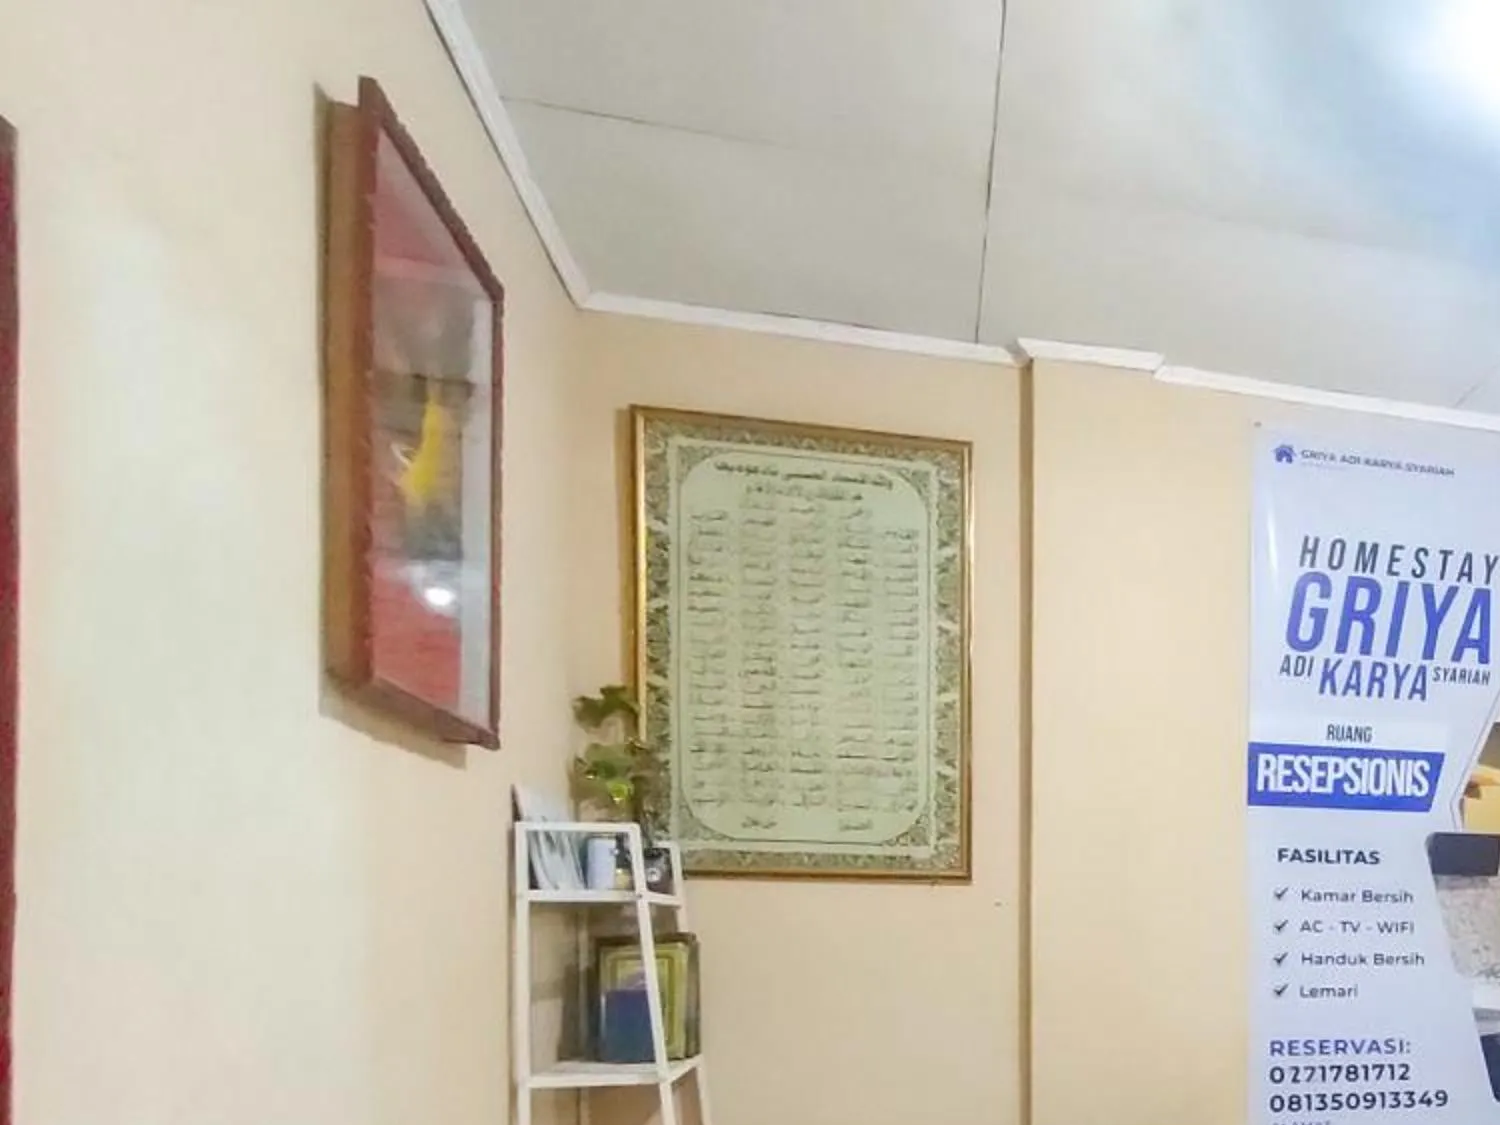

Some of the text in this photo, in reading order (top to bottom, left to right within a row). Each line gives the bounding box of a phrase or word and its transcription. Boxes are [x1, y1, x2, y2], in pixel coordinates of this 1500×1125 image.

[1299, 535, 1500, 585] HOMESTAY
[1286, 571, 1491, 665] GRIYA
[1279, 654, 1490, 701] ADI KARYA SYARIAH
[1326, 724, 1373, 743] RUANG
[1256, 753, 1431, 797] RESEPSIONIS
[1277, 848, 1381, 865] FASILITAS
[1301, 888, 1414, 903] Kamar Bersih
[1300, 920, 1324, 933] AC
[1340, 921, 1361, 933] TV
[1376, 921, 1415, 934] WIFI
[1301, 952, 1425, 966] Handuk Bersih
[1300, 984, 1358, 998] Lemari
[1270, 1038, 1411, 1057] RESERVASI:
[1269, 1063, 1411, 1084] 0271781712
[1269, 1089, 1449, 1113] 081350913349
